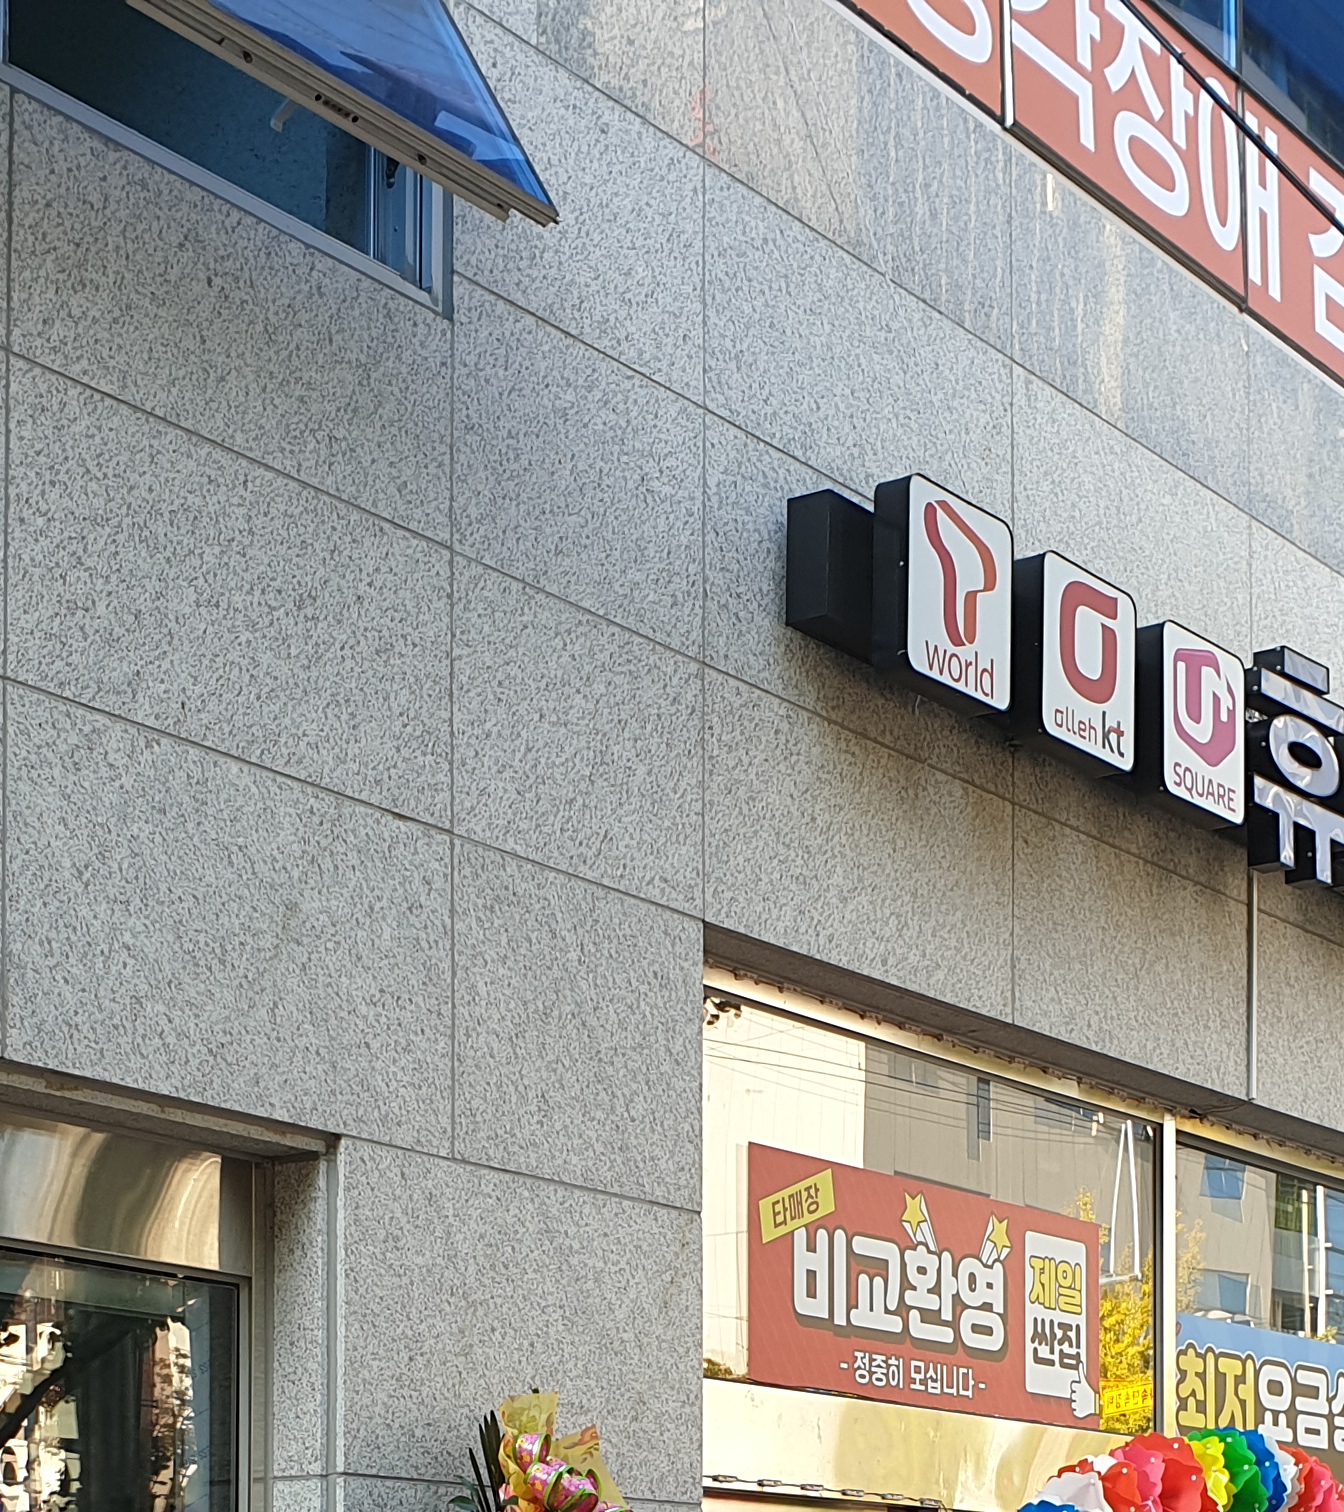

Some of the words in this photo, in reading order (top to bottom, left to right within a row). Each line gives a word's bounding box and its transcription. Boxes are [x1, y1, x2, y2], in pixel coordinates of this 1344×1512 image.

[924, 638, 996, 700] world
[1172, 761, 1237, 814] SQUARE
[771, 1183, 822, 1229] 타매장
[792, 1226, 1007, 1353] 비교환영
[1029, 1256, 1083, 1315] 제일
[1030, 1316, 1083, 1370] 싼집
[853, 1350, 905, 1389] 정중히
[909, 1360, 975, 1400] 모십니다
